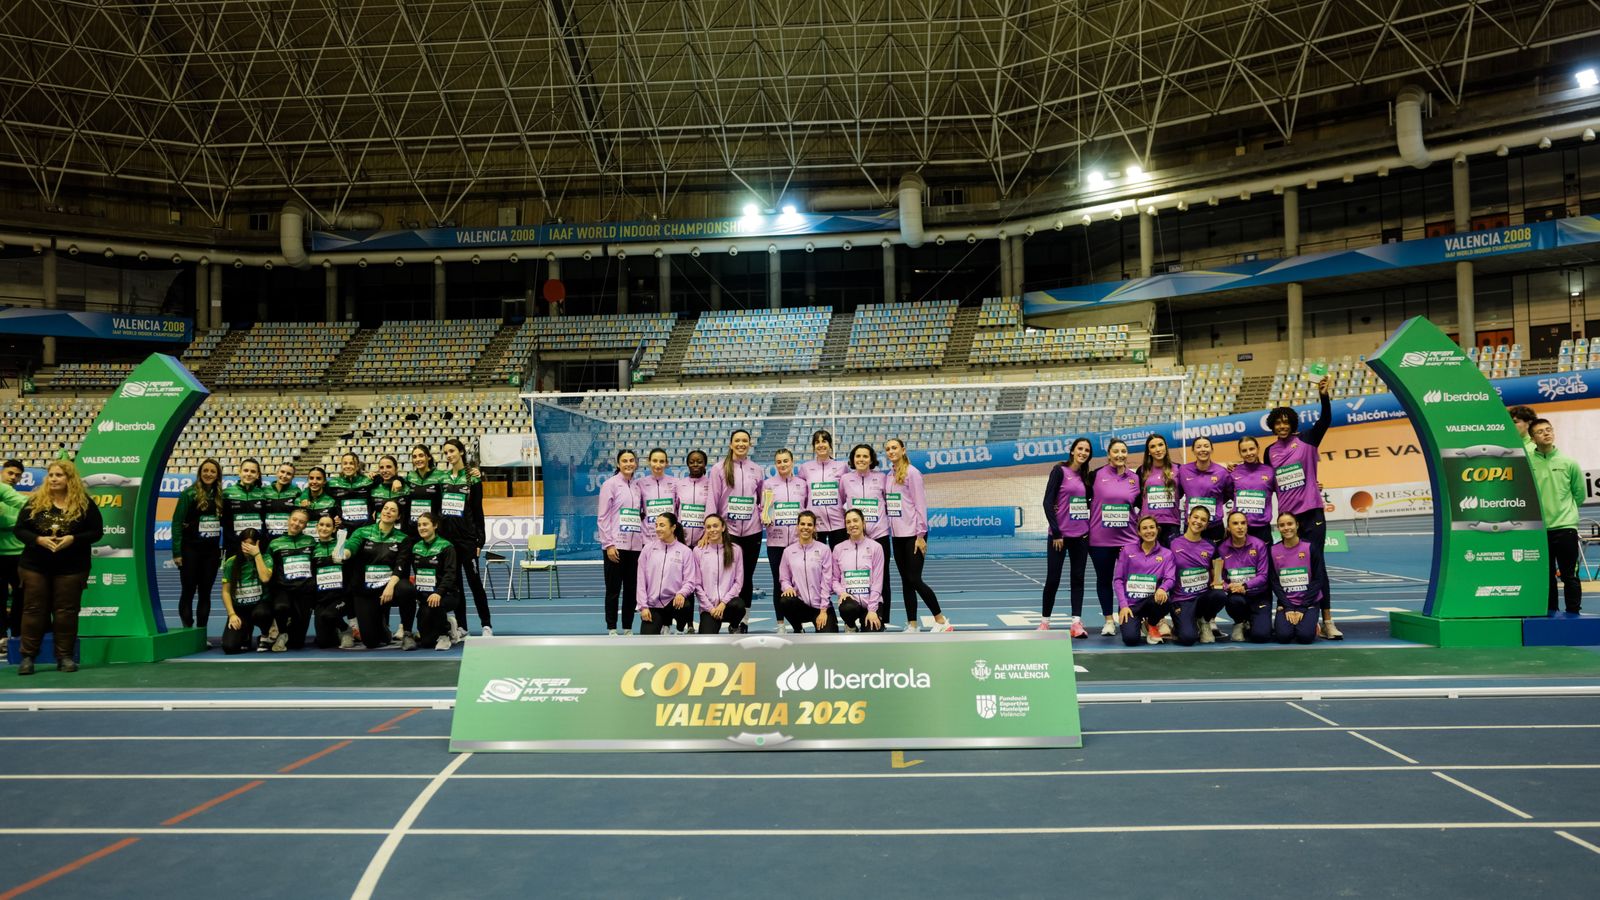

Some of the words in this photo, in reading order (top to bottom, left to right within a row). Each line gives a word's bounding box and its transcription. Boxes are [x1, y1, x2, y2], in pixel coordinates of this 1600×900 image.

[456, 230, 508, 243] VALENCIA
[510, 228, 535, 242] 2008
[549, 226, 574, 240] IAAF
[577, 224, 617, 239] WORLD
[620, 222, 661, 237] INDOOR
[664, 220, 745, 235] CHAMPIONSHI
[1444, 232, 1501, 251] VALENCIA
[1504, 227, 1532, 243] 2008
[1456, 249, 1473, 257] WORLD
[112, 317, 160, 332] VALENCIA
[162, 320, 185, 333] 2008
[1443, 392, 1489, 402] Iberdrola
[1347, 409, 1388, 422] Halcón
[115, 421, 156, 431] Iberdrola
[1182, 421, 1245, 440] MONDO
[1345, 447, 1380, 459] DE
[82, 456, 120, 464] VALENCIA
[1461, 467, 1513, 482] COPA
[1480, 498, 1526, 508] Iberdrola
[950, 516, 1002, 527] Iberdrola
[103, 525, 126, 535] drola
[994, 663, 1049, 671] AJUNTAMENT
[620, 662, 756, 697] COPA
[824, 668, 932, 689] Iberdrola
[1008, 670, 1050, 679] VALÈNCIA
[524, 687, 587, 695] ATLETISMO
[655, 702, 788, 726] VALENCIA
[794, 701, 867, 725] 2026
